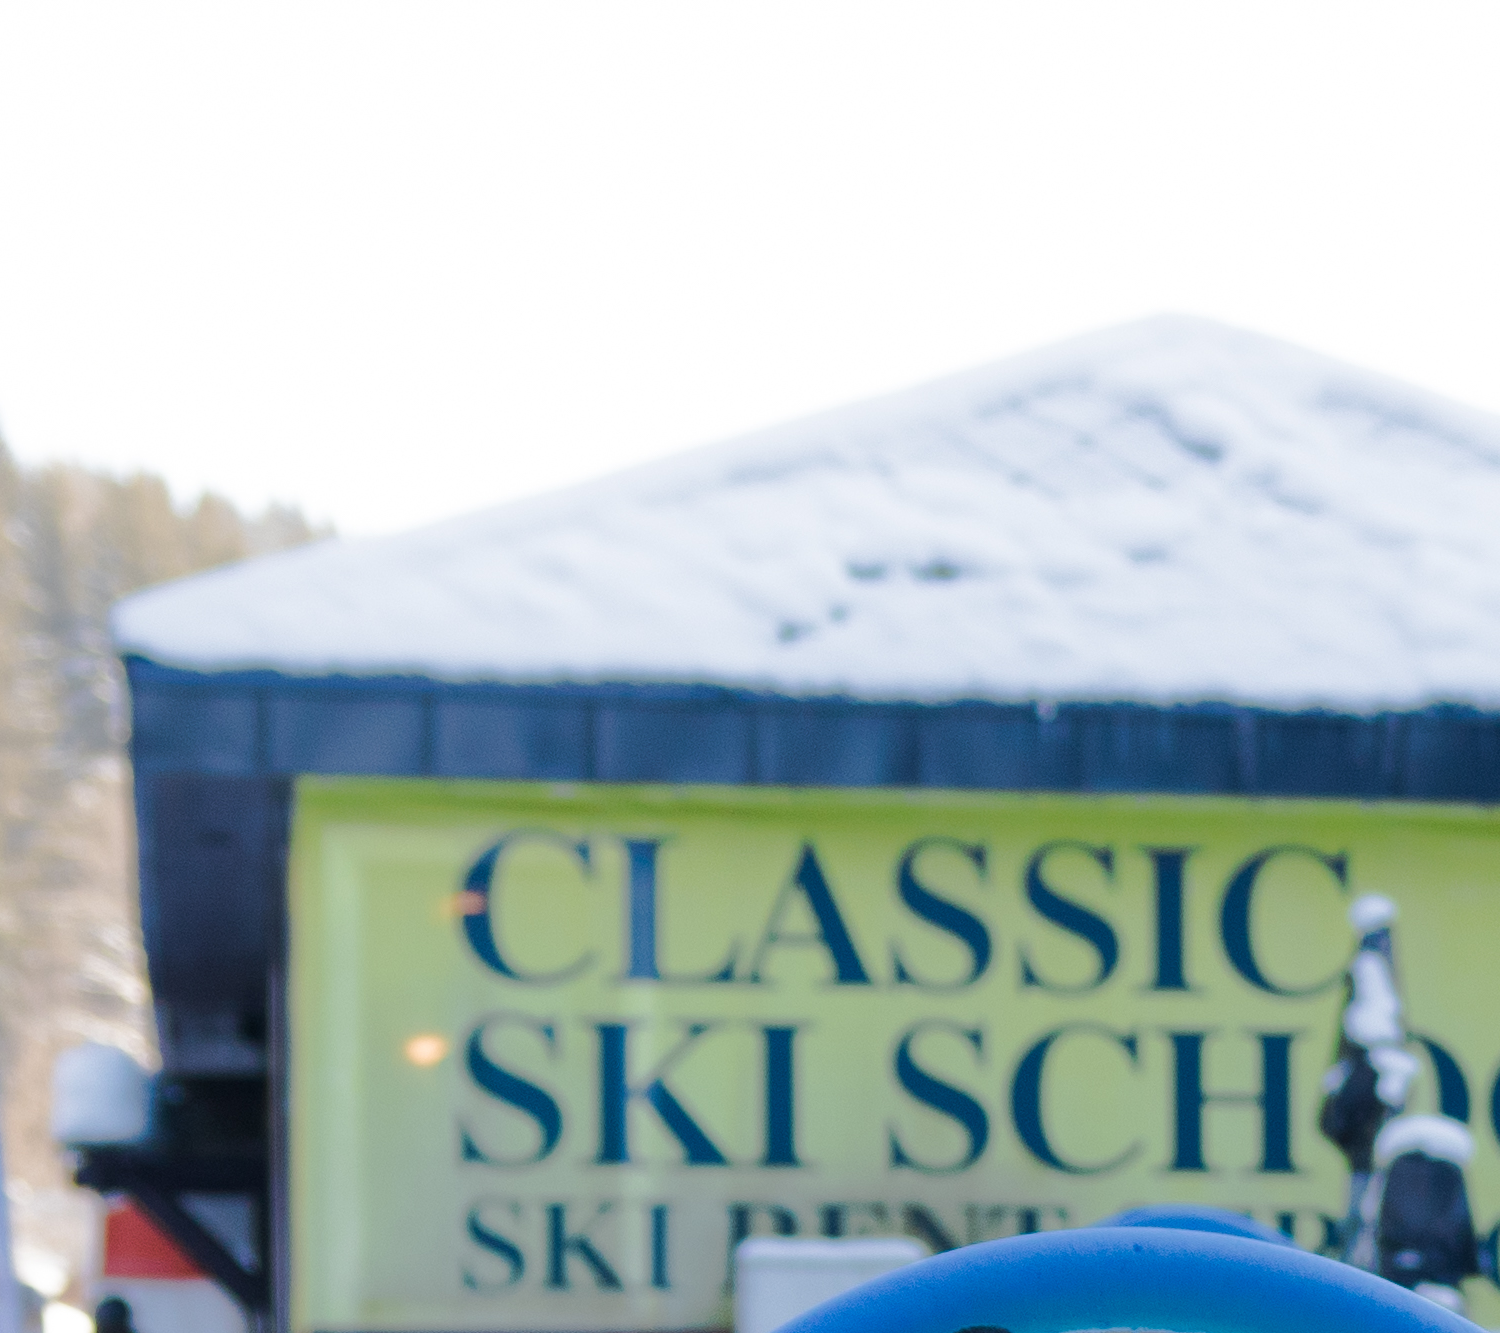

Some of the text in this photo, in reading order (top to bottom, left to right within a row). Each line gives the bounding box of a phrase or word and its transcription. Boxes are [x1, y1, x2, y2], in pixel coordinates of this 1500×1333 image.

[457, 827, 1351, 998] CLASSIC
[458, 1012, 816, 1170] SKI
[461, 1202, 670, 1291] SKI
